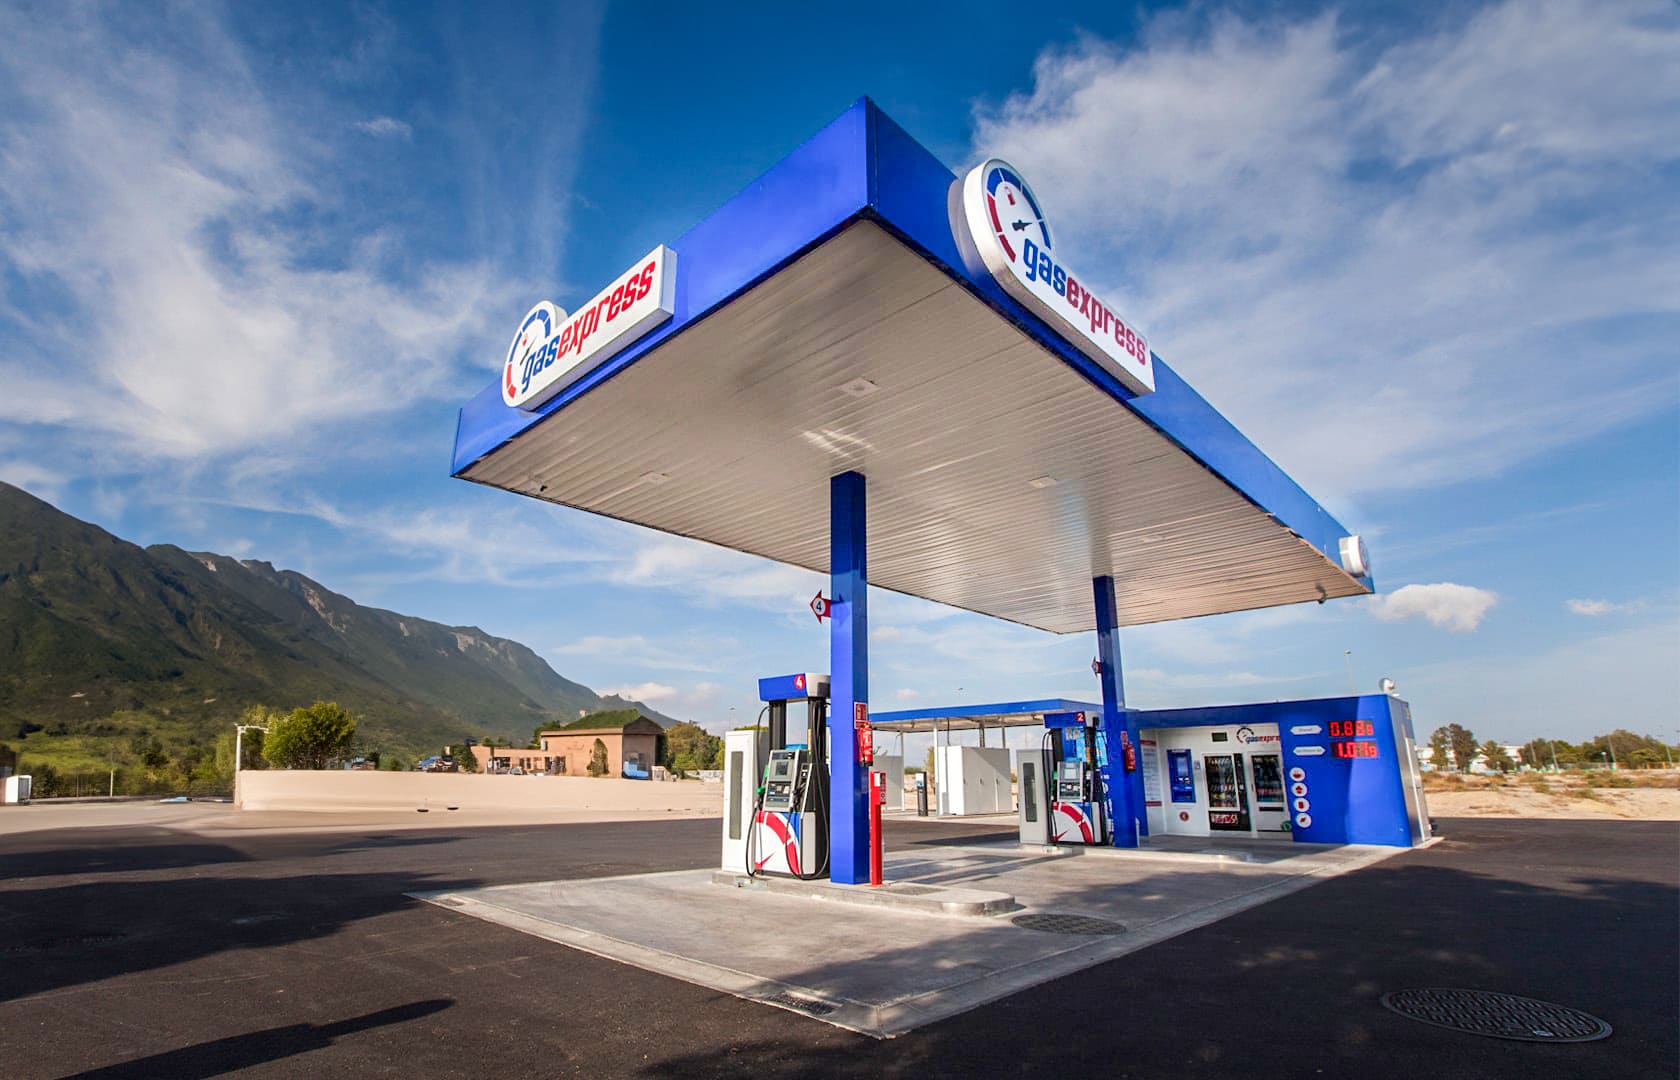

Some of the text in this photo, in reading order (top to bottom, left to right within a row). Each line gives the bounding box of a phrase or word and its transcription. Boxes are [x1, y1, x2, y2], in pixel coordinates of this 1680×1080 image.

[1023, 238, 1147, 366] gasexpress
[521, 260, 656, 394] gasexpress
[816, 601, 822, 612] 4
[796, 676, 803, 690] 4
[1077, 713, 1084, 722] 2
